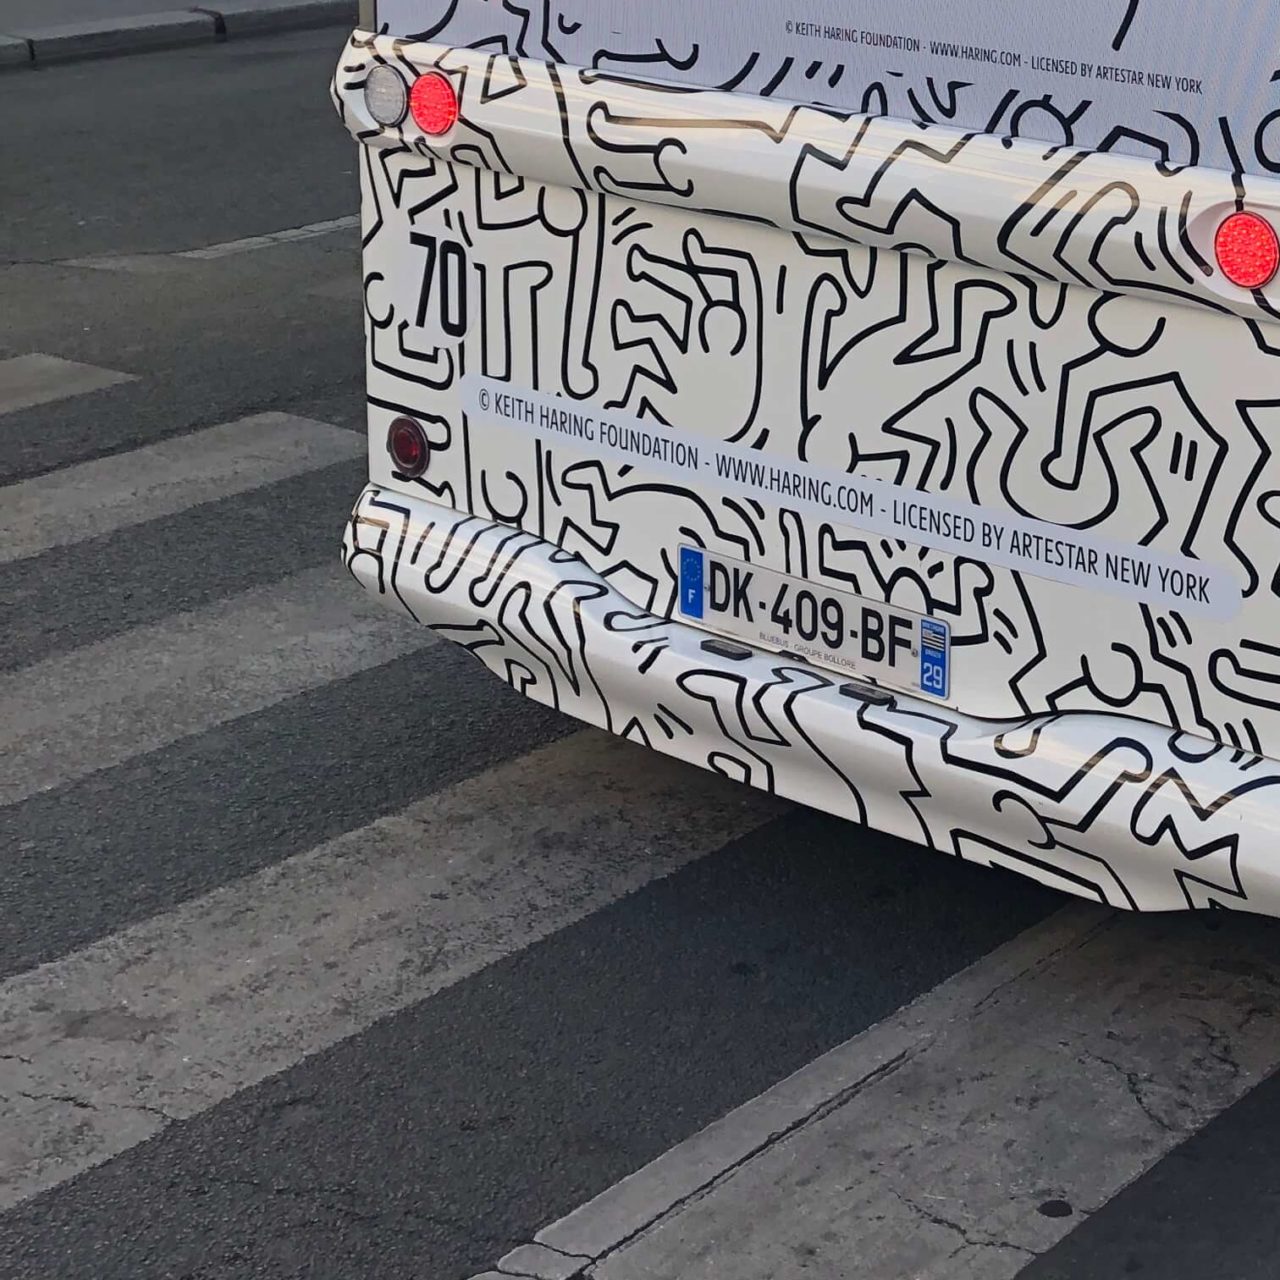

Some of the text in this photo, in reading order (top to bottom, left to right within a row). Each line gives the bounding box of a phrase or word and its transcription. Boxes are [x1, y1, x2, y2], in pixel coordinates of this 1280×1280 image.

[795, 22, 822, 38] KEITH
[823, 26, 858, 43] HARING
[860, 30, 921, 52] FOUNDATION
[930, 40, 1021, 67] WWW.HARING.COM
[1031, 56, 1078, 76] LICENSED
[1081, 63, 1093, 79] BY
[1095, 65, 1144, 86] ARTESTAR
[1147, 73, 1172, 90] NEW
[1174, 77, 1203, 95] YORK
[409, 231, 467, 338] 70
[494, 392, 534, 424] KEITH
[539, 405, 595, 441] HARING
[599, 421, 699, 470] FOUNDATION
[716, 453, 874, 517] WWW.HARING.COM
[893, 499, 975, 543] LICENSED
[982, 522, 1005, 551] BY
[1009, 530, 1099, 576] ARTESTAR
[1105, 552, 1151, 589] NEW
[1157, 565, 1211, 604] YORK
[688, 588, 696, 603] F
[793, 644, 822, 660] GROUPE
[923, 662, 943, 690] 29
